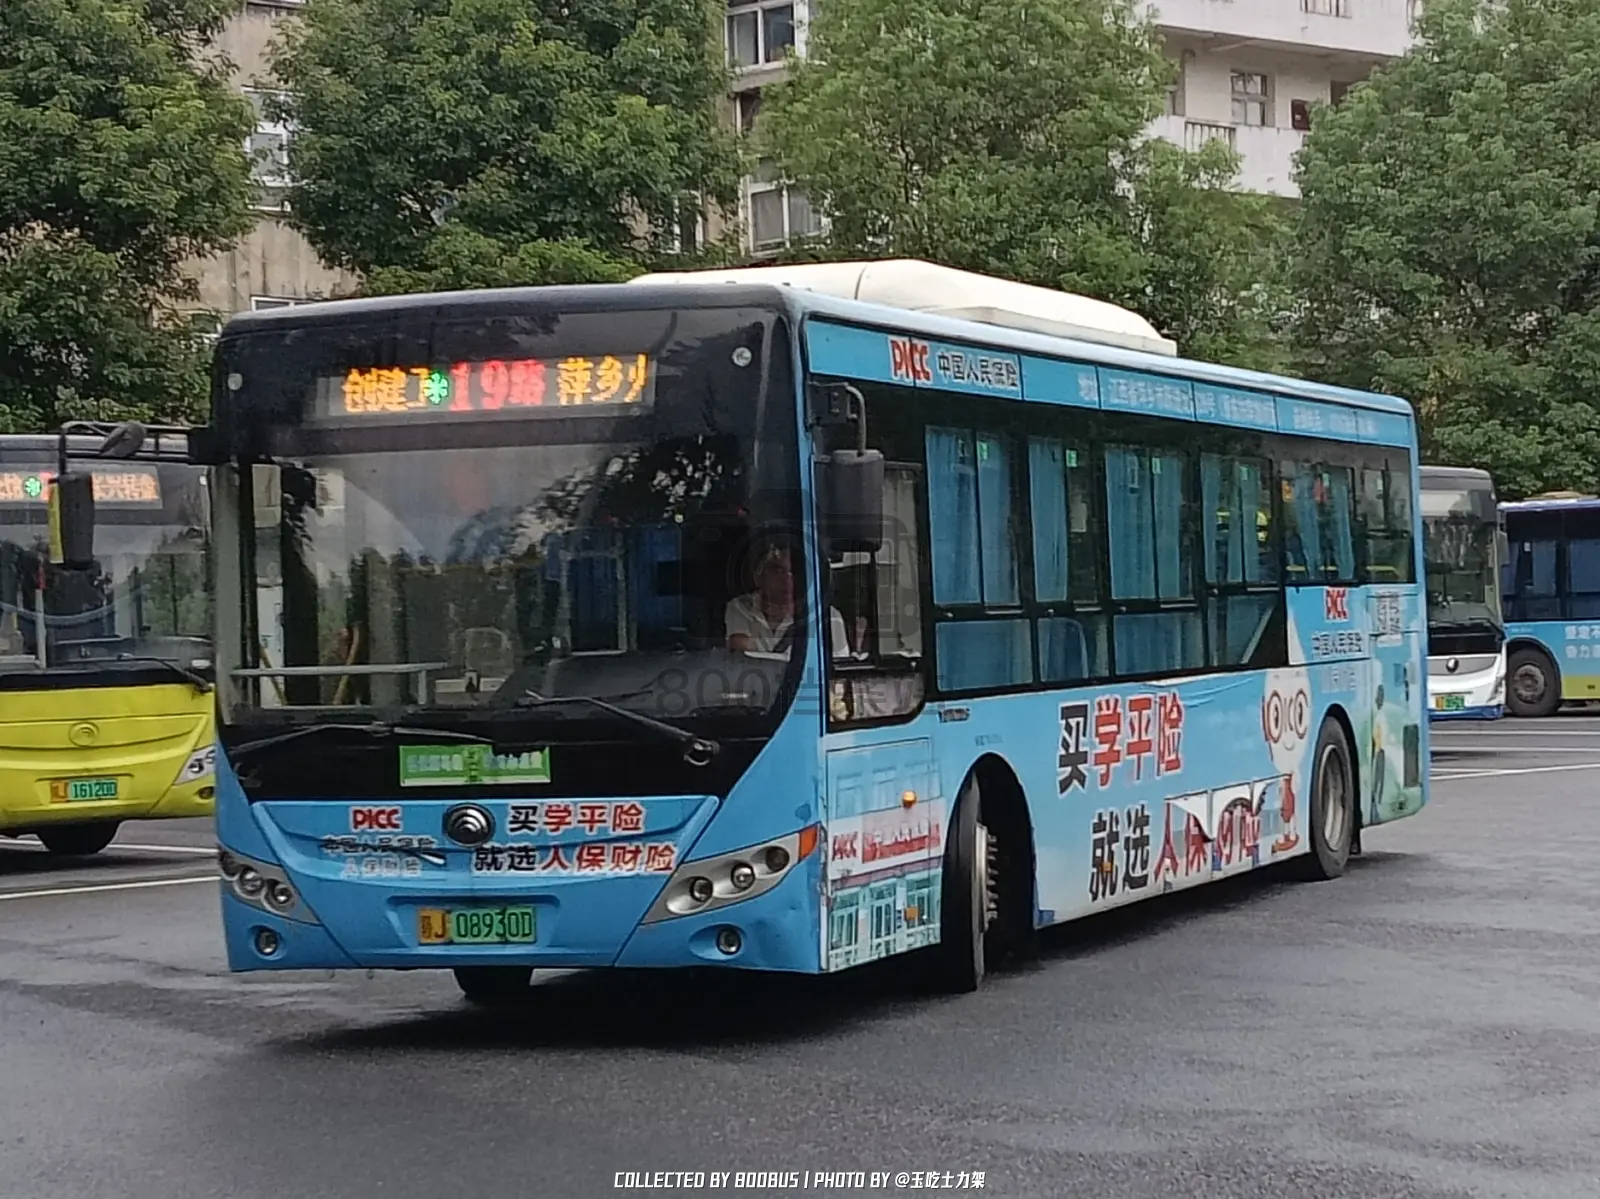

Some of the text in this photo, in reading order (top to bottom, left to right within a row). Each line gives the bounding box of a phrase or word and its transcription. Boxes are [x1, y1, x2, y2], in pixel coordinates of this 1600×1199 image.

[889, 338, 932, 382] PICC
[1058, 692, 1184, 796] 买学平险
[352, 808, 401, 830] PICC
[508, 804, 643, 833] 买学平险
[474, 844, 675, 872] 就选人保财险
